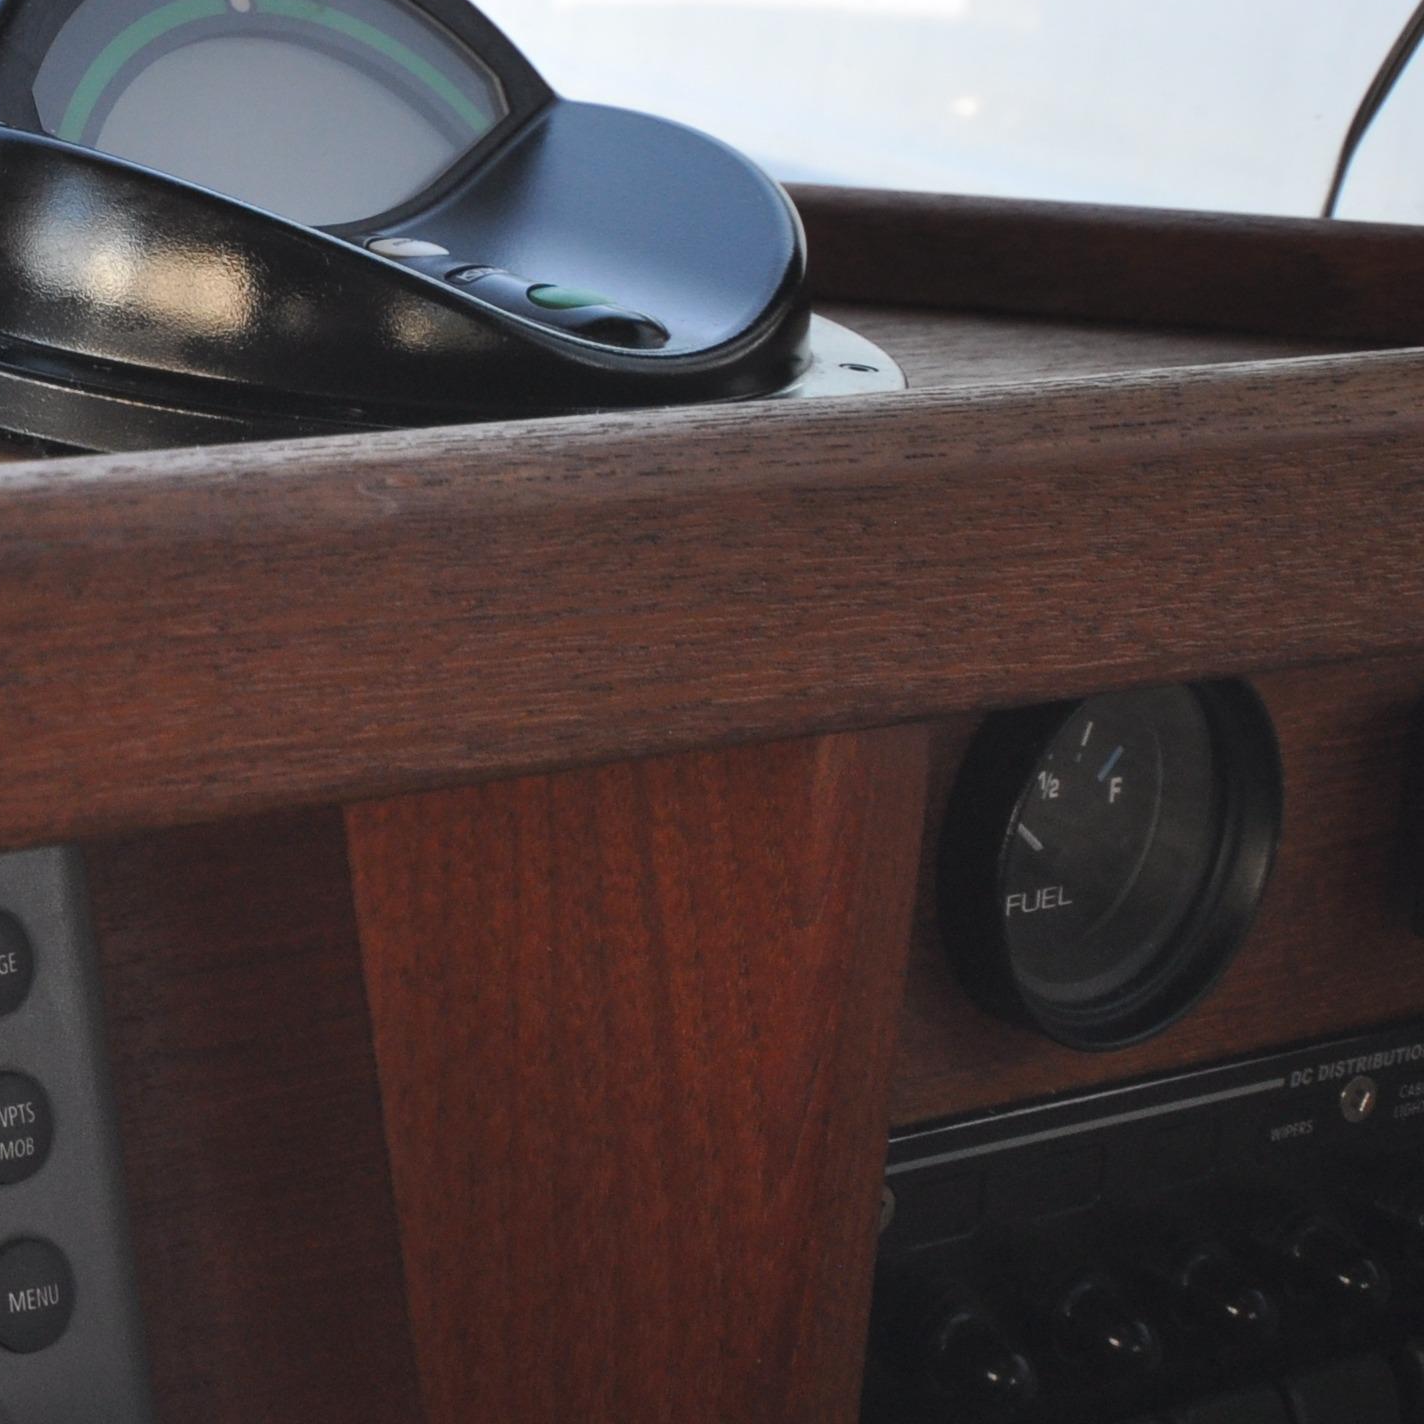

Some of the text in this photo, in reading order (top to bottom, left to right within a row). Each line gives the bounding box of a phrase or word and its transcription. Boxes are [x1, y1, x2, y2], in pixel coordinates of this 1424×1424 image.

[1109, 777, 1123, 803] F
[1005, 885, 1073, 917] FUEL
[1289, 1044, 1424, 1089] DC DISTRIBUTIO
[1270, 1119, 1313, 1142] WIPERS
[0, 1137, 35, 1161] MOB
[9, 1283, 60, 1313] MENU
